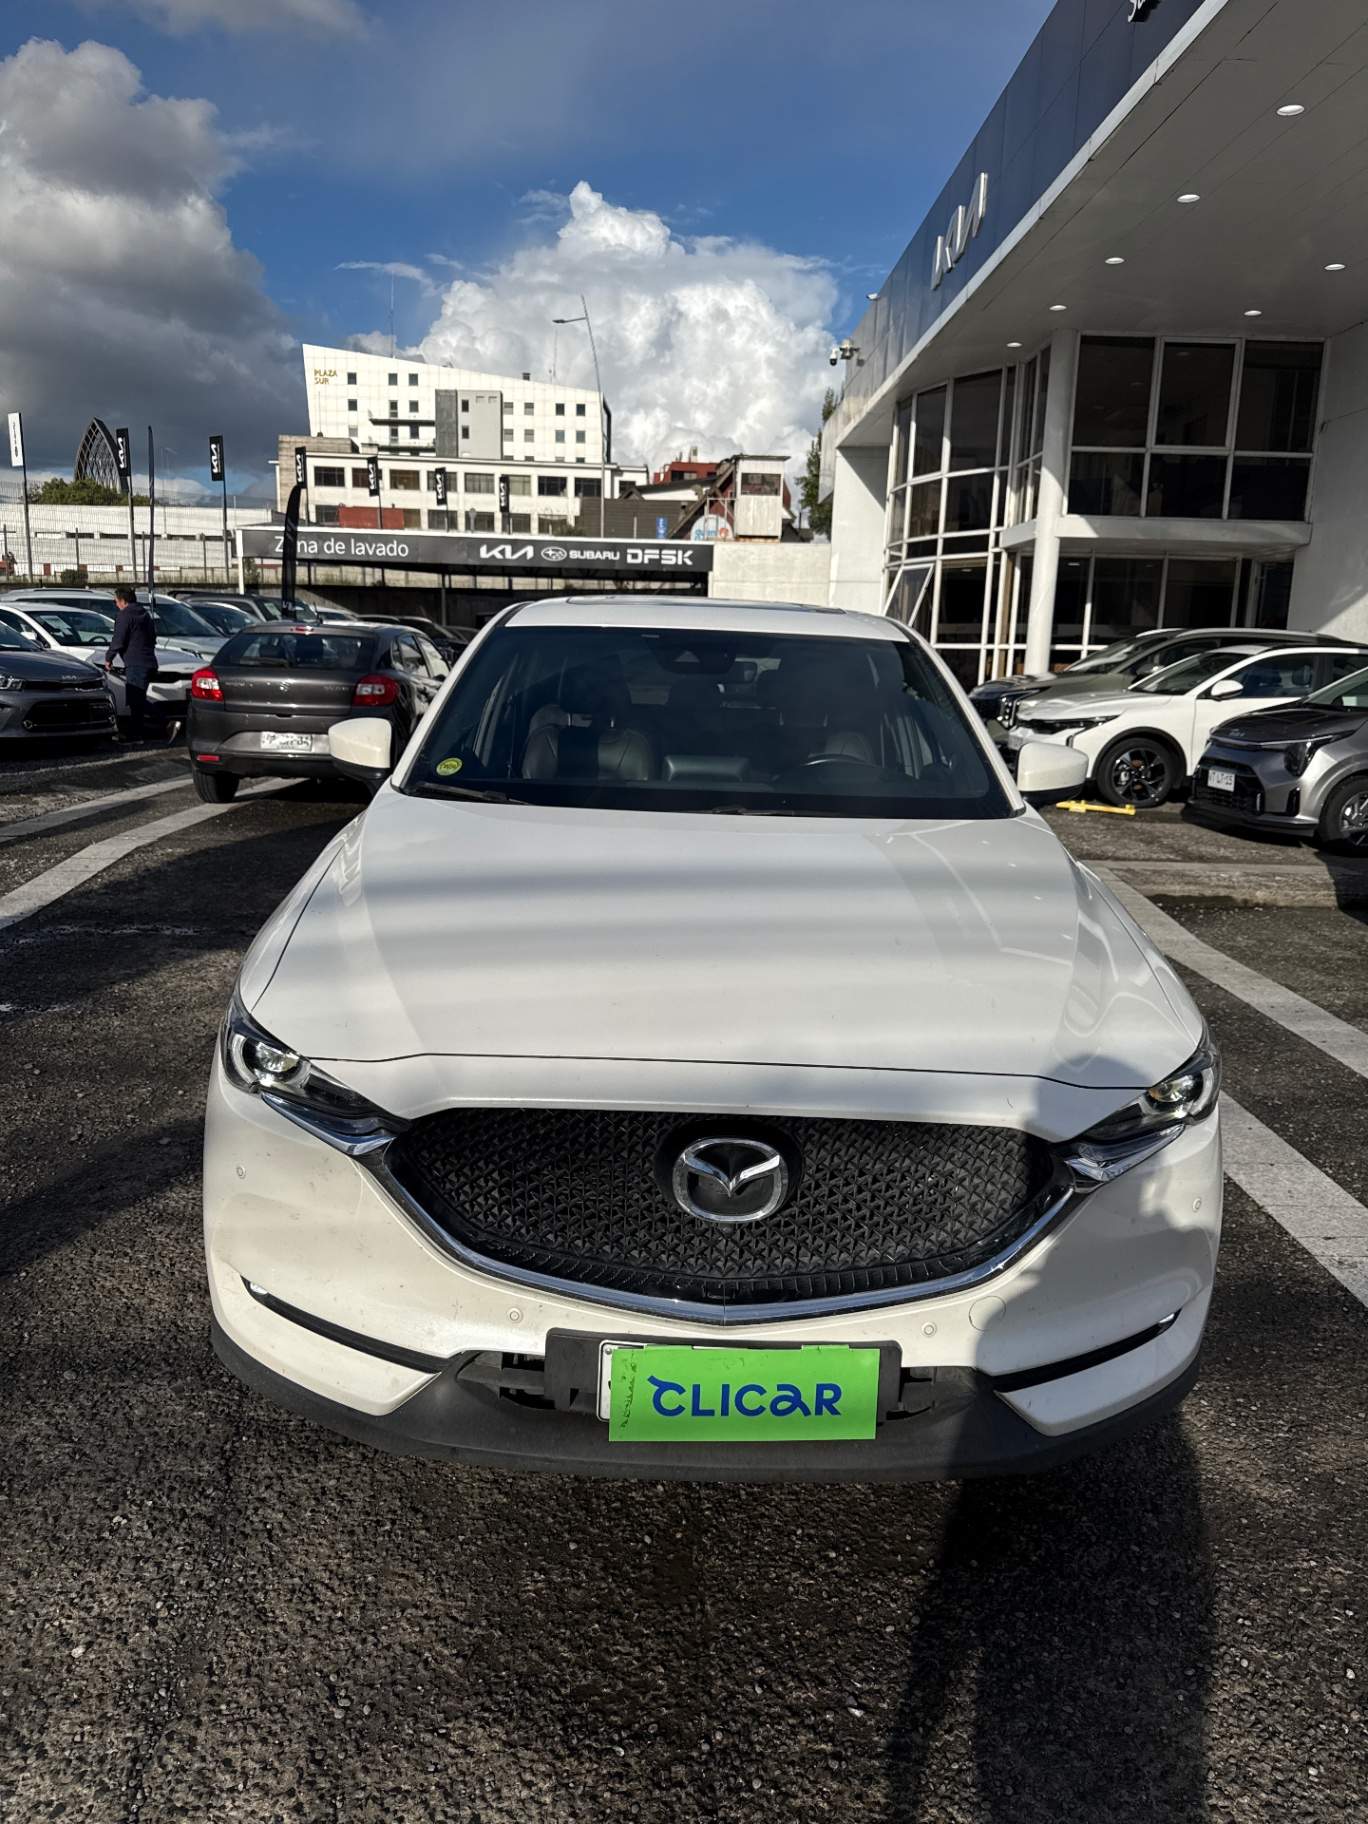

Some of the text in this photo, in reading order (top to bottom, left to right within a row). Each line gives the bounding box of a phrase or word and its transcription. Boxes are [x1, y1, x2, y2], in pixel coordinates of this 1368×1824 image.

[931, 172, 988, 290] KIA
[314, 369, 337, 377] PLAZA
[314, 377, 330, 385] SUR
[274, 536, 409, 557] Zna de lavado
[479, 544, 534, 560] KIA
[569, 549, 620, 560] SUBARU
[626, 548, 693, 565] DFSK
